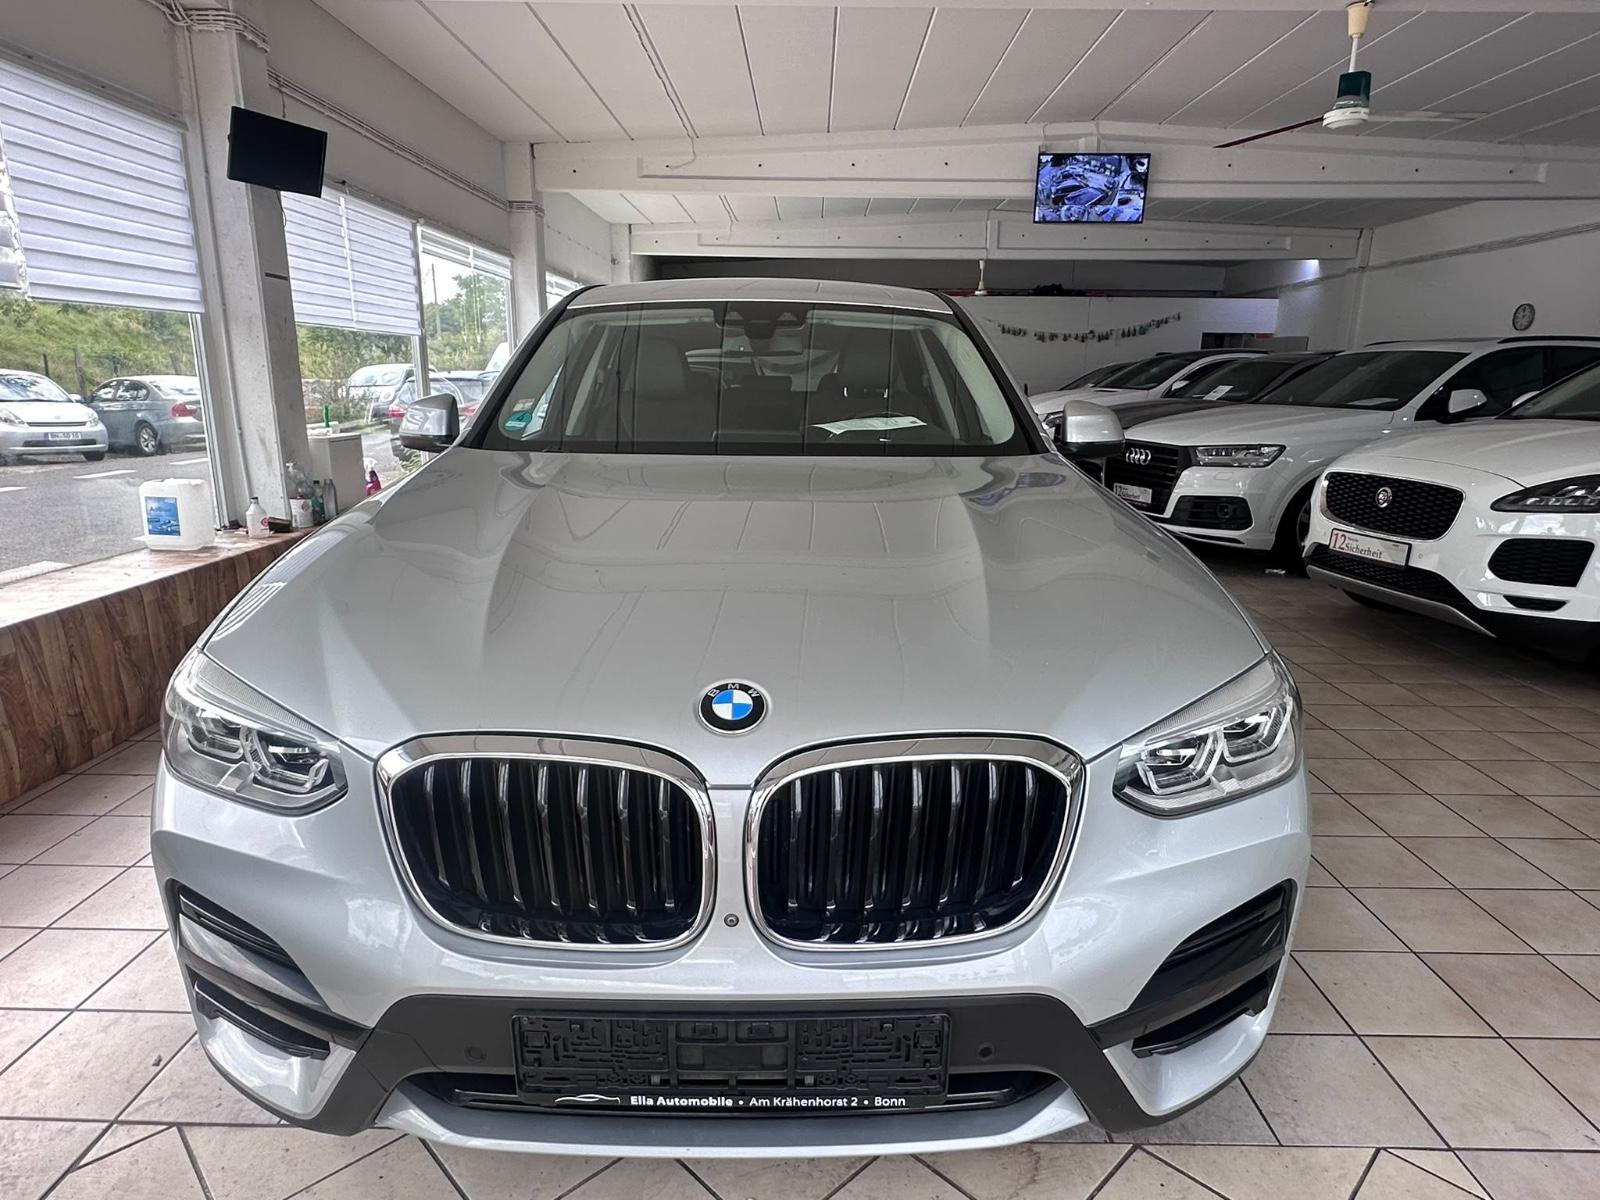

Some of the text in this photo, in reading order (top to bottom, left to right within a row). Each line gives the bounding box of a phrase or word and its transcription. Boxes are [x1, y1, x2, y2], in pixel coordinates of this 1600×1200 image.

[1332, 532, 1383, 559] 12 Sicherheit
[707, 683, 760, 698] BMW
[749, 1097, 770, 1106] Am
[773, 1097, 848, 1106] Krähenhorst
[850, 1097, 858, 1106] 2
[874, 1096, 906, 1106] Bonn
